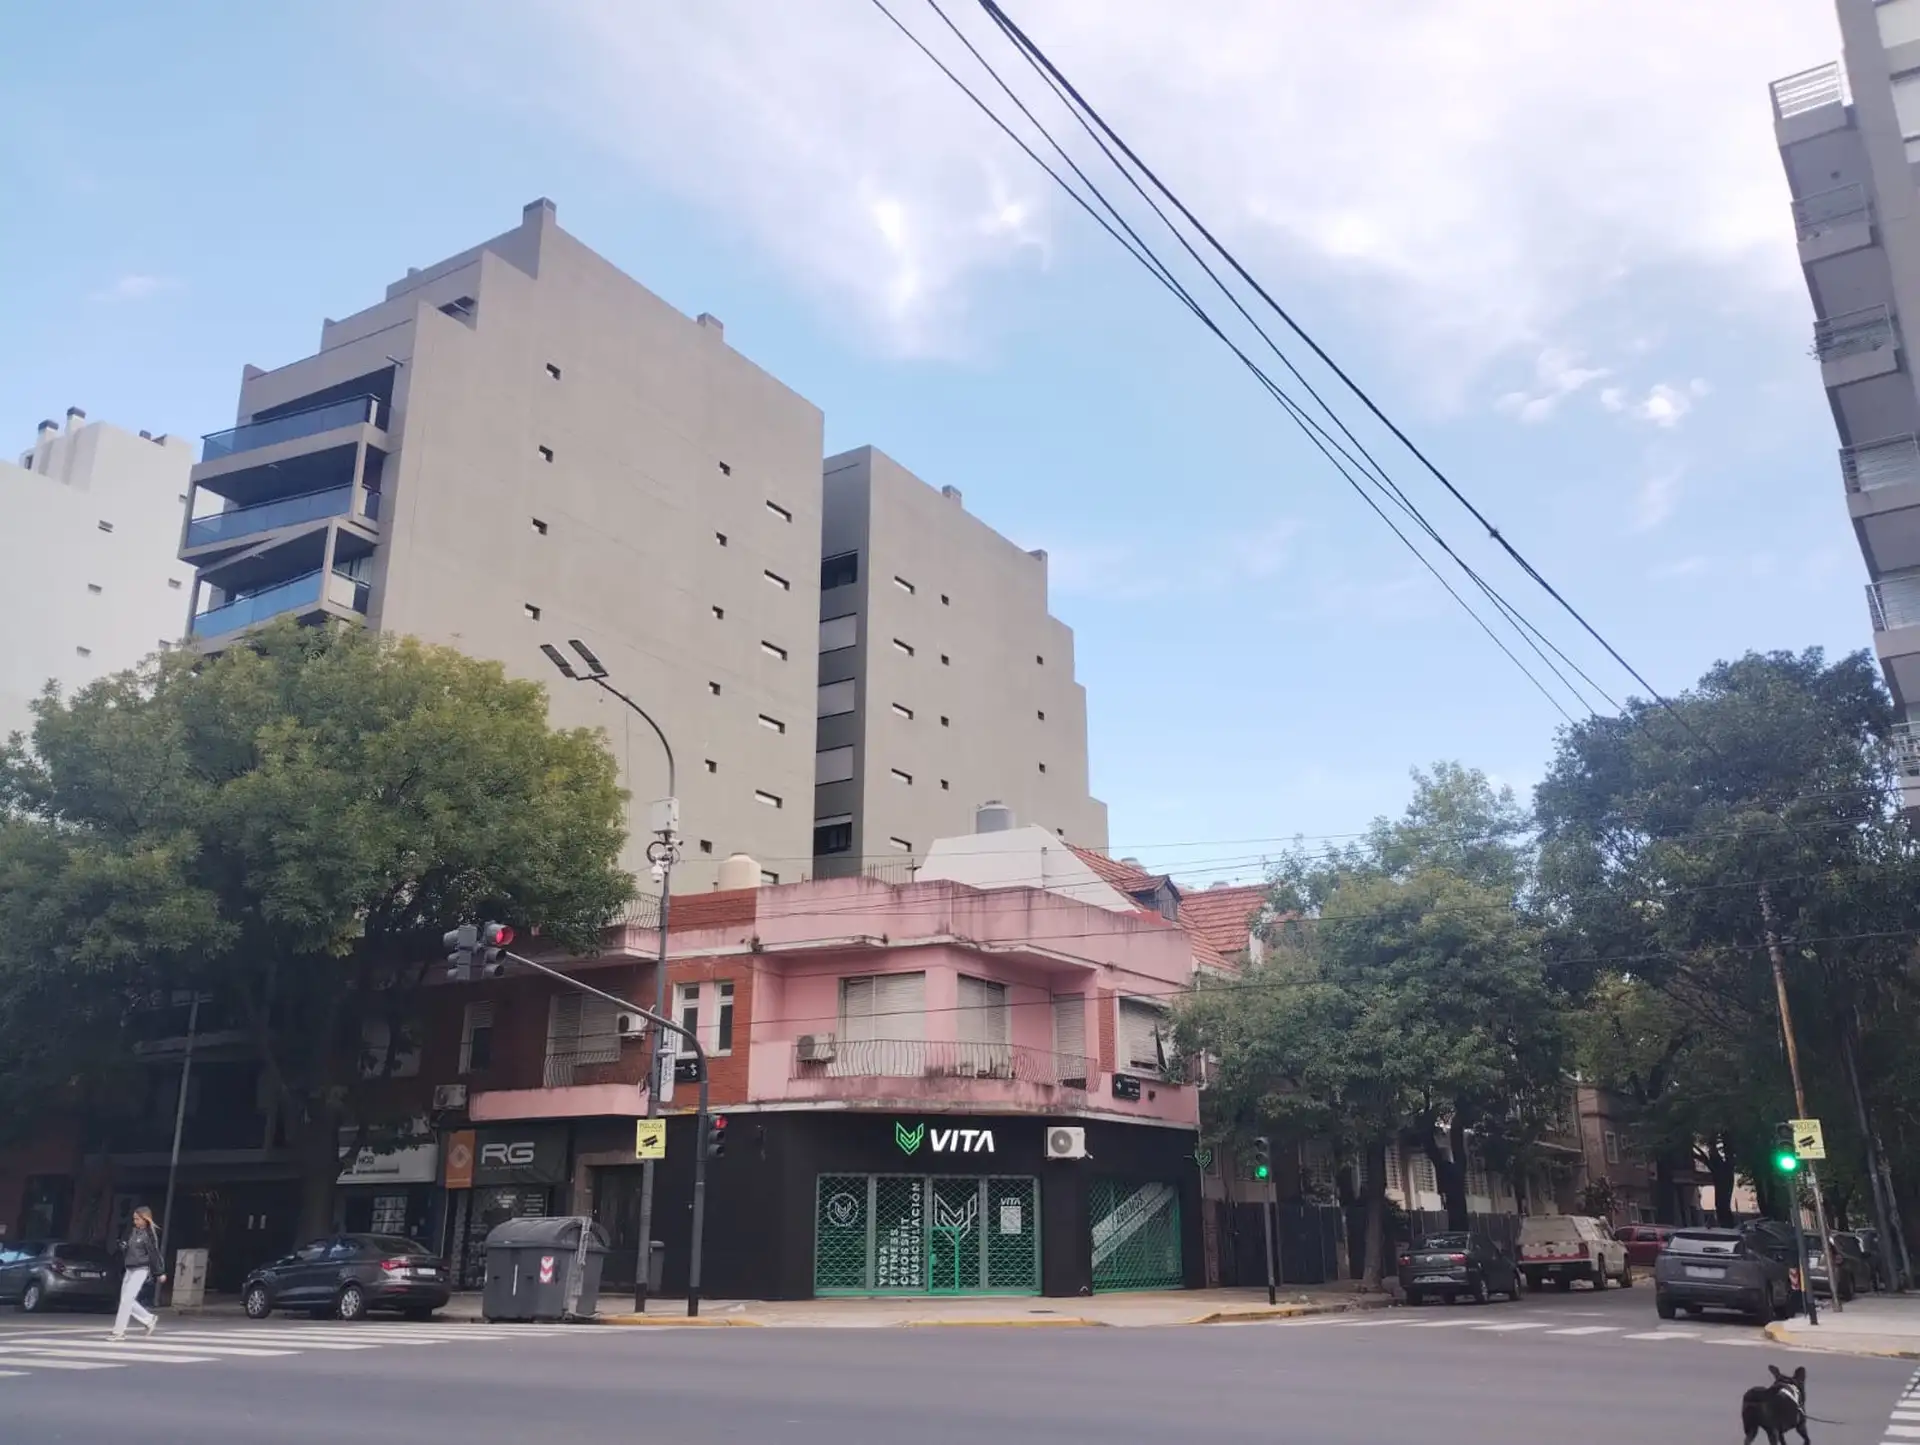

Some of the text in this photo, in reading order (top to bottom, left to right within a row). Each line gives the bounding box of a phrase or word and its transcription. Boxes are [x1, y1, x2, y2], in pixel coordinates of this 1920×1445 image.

[481, 1142, 535, 1164] RG
[930, 1128, 995, 1152] VITA
[1000, 1197, 1021, 1206] VITA
[900, 1217, 910, 1286] CROSSFIT
[911, 1182, 920, 1285] MUSCULACION
[879, 1246, 888, 1285] YOGA
[890, 1228, 899, 1285] FITNESS
